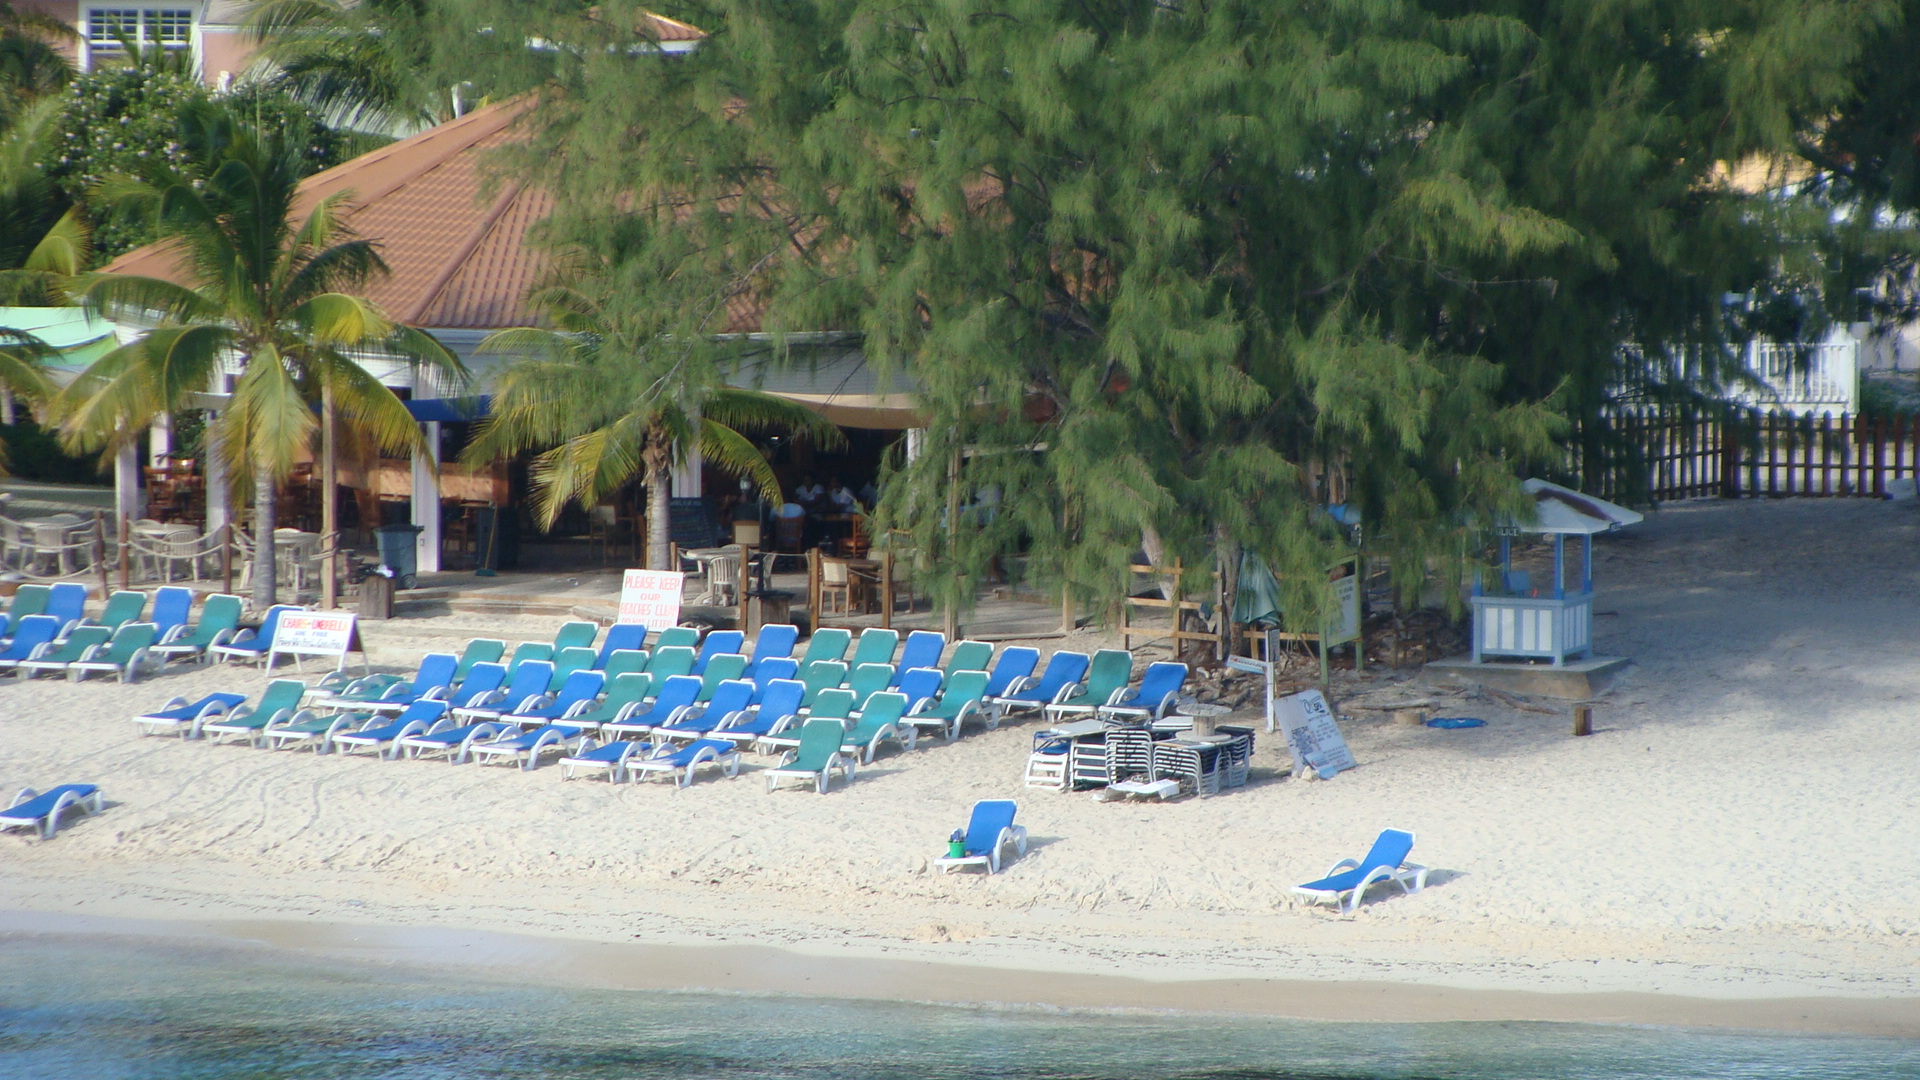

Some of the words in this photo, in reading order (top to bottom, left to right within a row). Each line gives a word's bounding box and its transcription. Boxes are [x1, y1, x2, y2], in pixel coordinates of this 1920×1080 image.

[625, 576, 656, 589] PLEASE
[659, 577, 681, 591] KEEP
[640, 593, 661, 601] OUR
[620, 603, 652, 615] BEACHES
